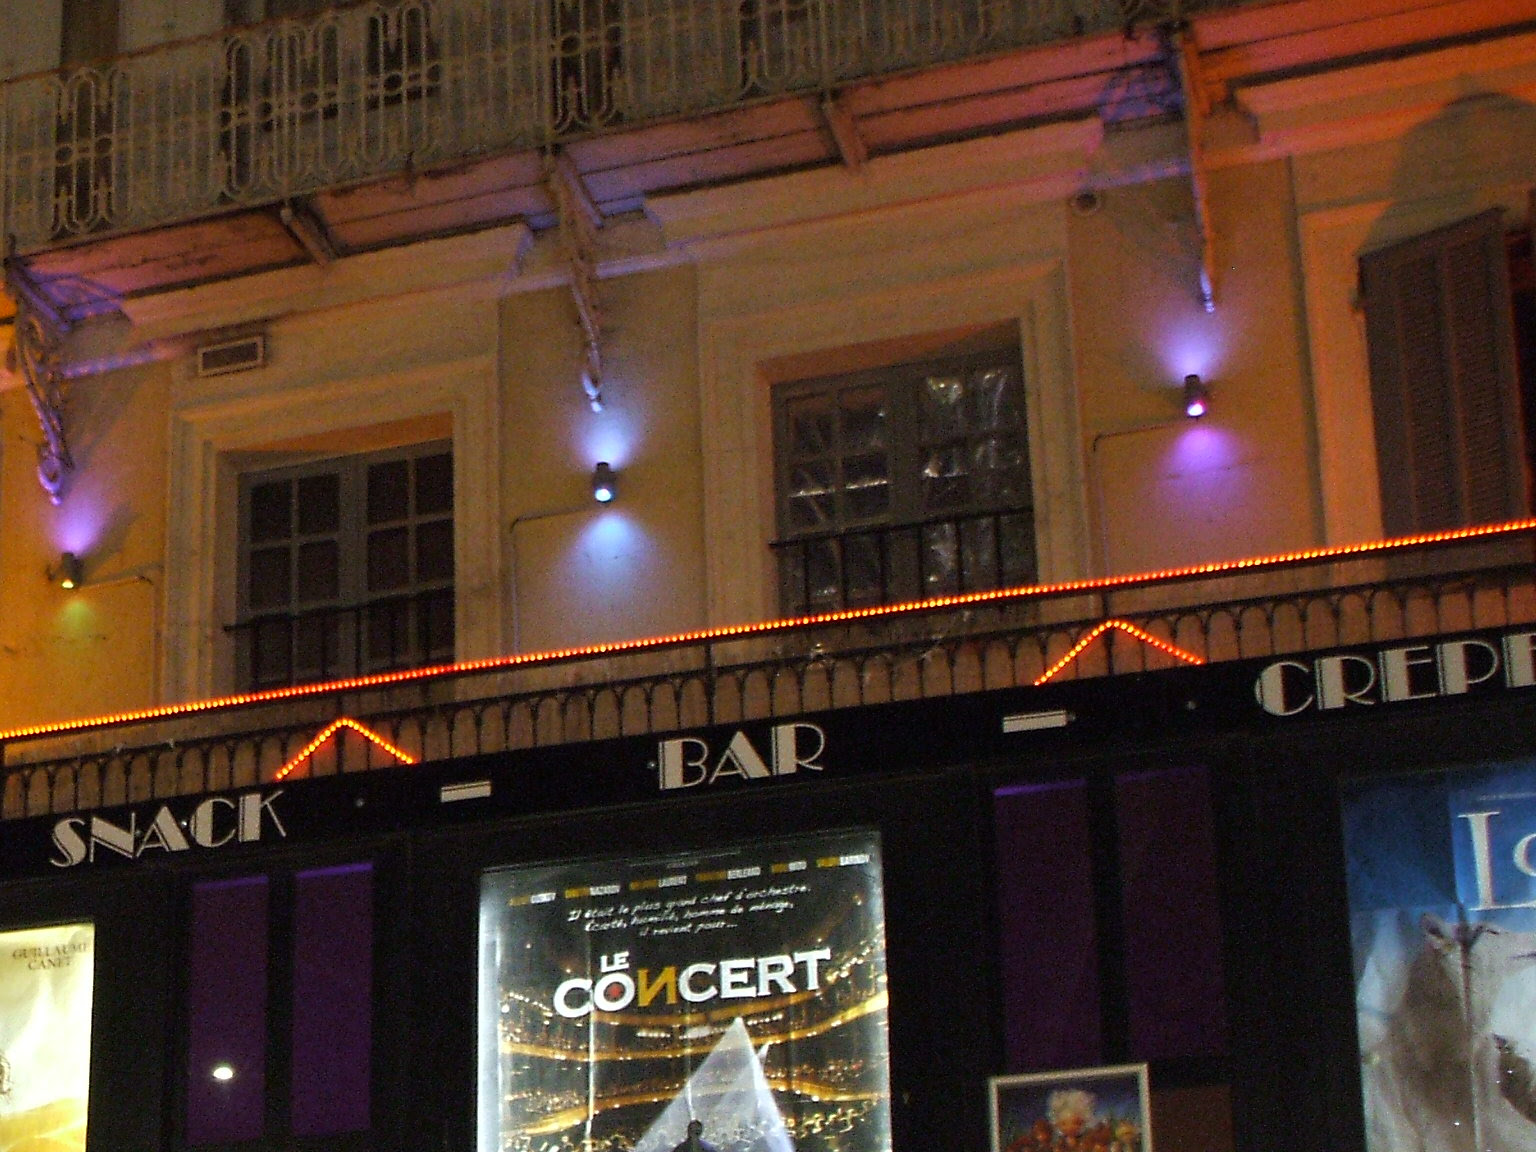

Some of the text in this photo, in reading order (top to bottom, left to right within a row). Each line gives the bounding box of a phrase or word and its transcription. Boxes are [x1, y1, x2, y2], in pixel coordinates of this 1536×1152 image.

[50, 790, 287, 868] SNACK
[658, 723, 825, 790] BAR
[600, 951, 629, 972] LE
